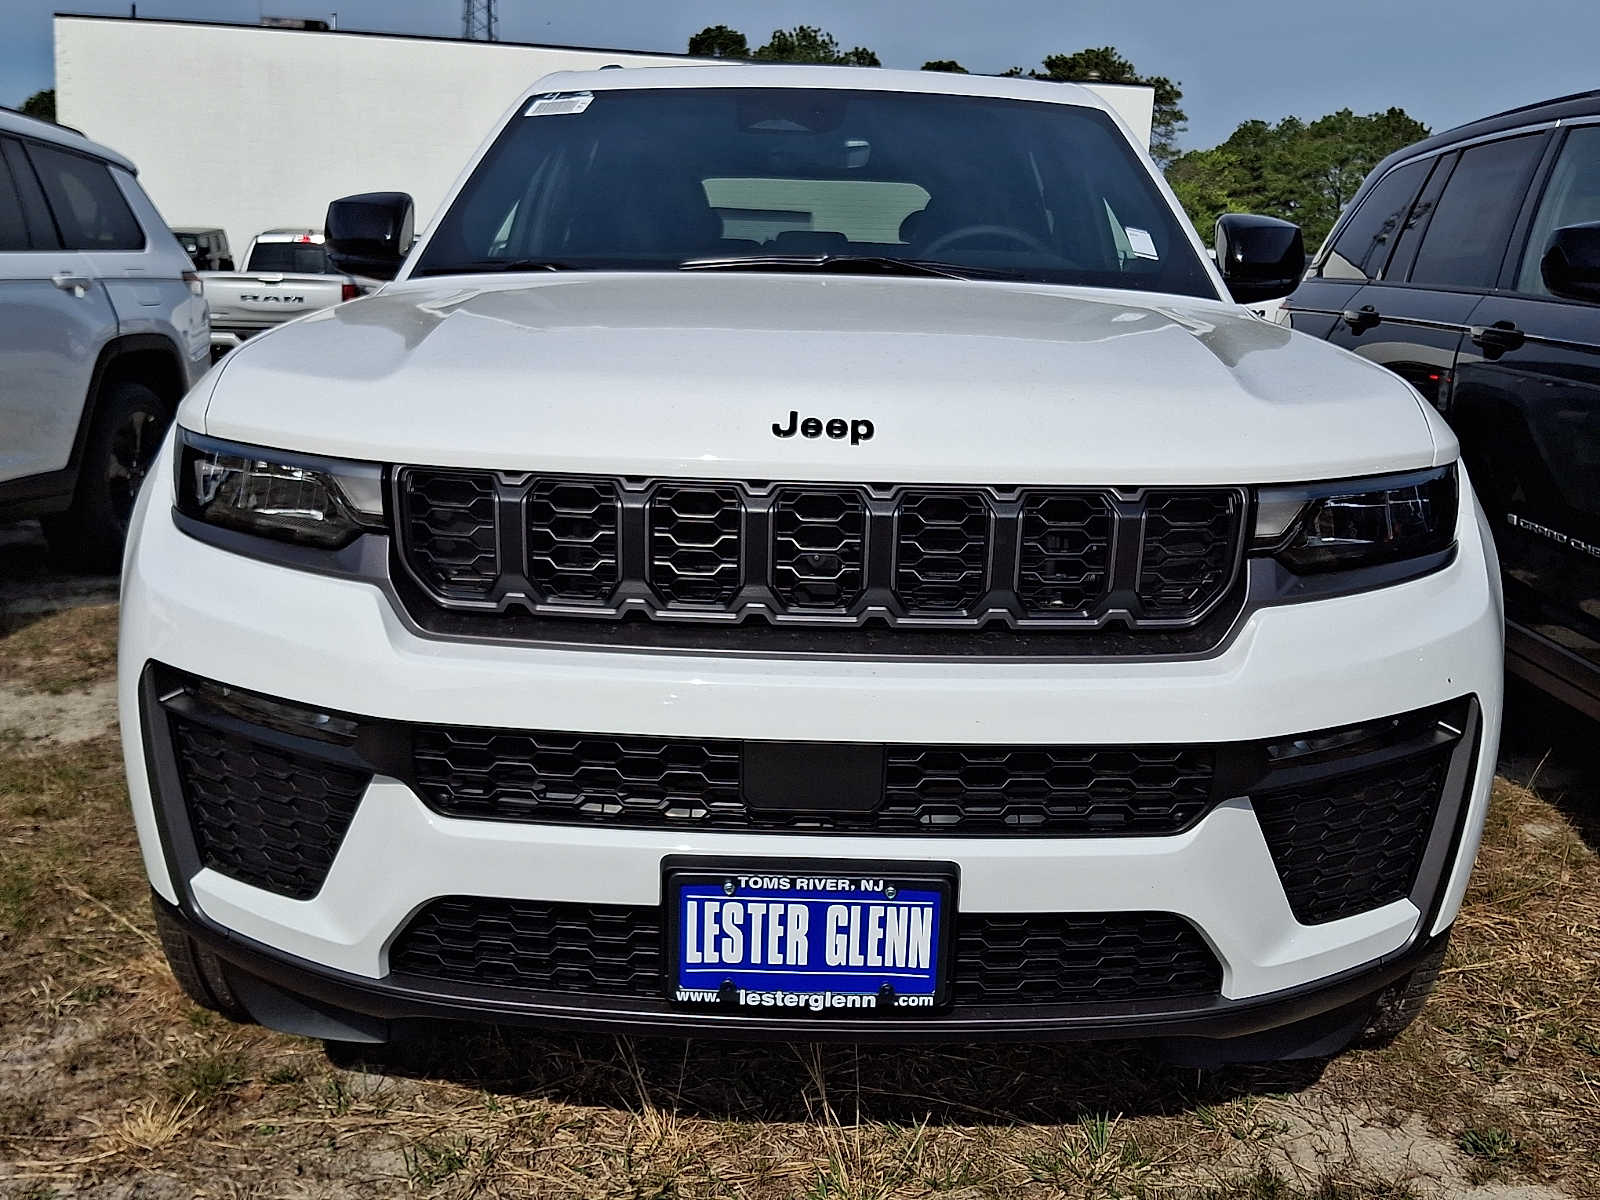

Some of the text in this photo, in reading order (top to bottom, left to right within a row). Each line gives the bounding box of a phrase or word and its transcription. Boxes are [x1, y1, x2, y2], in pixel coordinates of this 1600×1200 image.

[240, 295, 304, 304] RAM
[772, 410, 875, 445] Jeep
[1519, 518, 1567, 544] GRAND
[737, 876, 884, 892] TOMS RIVER, NJ
[685, 900, 934, 969] LESTER GLENN
[739, 988, 876, 1012] lesterglenn
